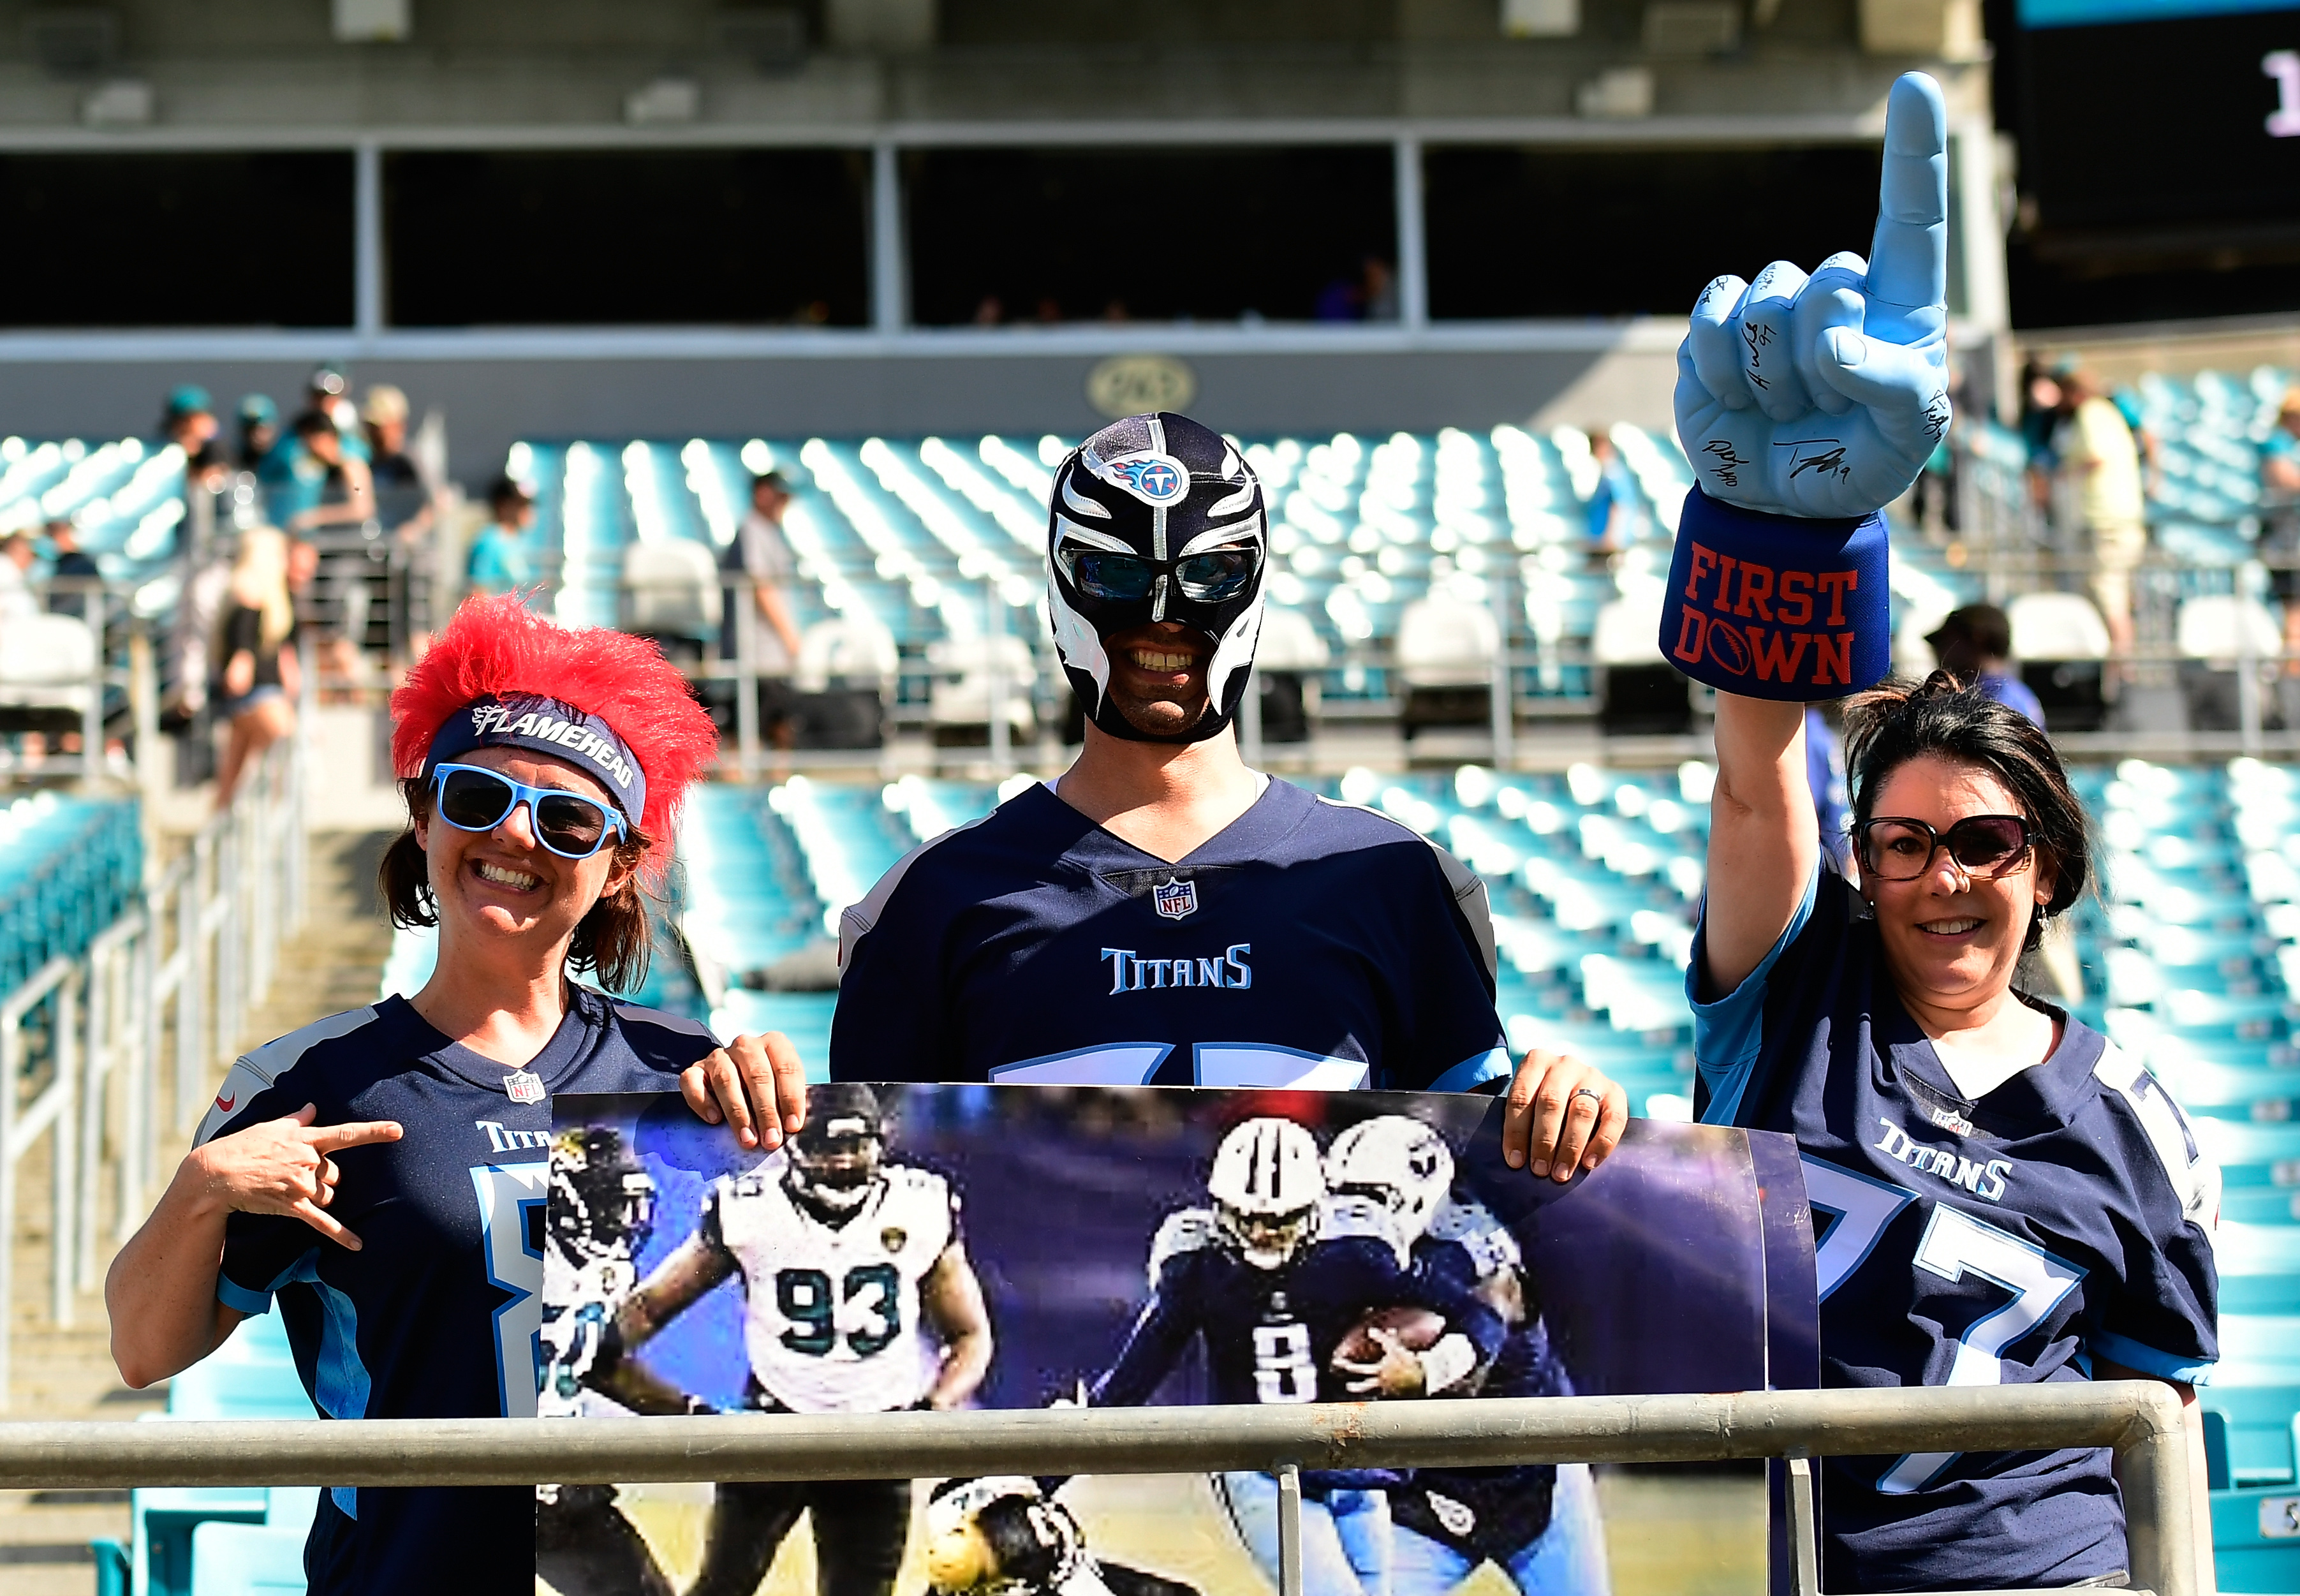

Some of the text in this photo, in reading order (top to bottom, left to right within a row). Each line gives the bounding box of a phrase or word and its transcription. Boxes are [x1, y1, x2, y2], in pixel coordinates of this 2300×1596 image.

[1684, 541, 1857, 626] FIRST
[1673, 603, 1854, 685] DOWN
[472, 705, 634, 790] FLAMEHEAD
[1161, 896, 1191, 913] NFL
[1101, 943, 1251, 996] TITANS
[513, 1084, 540, 1097] NFL
[476, 1121, 551, 1153] TITA
[1873, 1117, 2014, 1202] TITANS
[776, 1263, 901, 1360] 93
